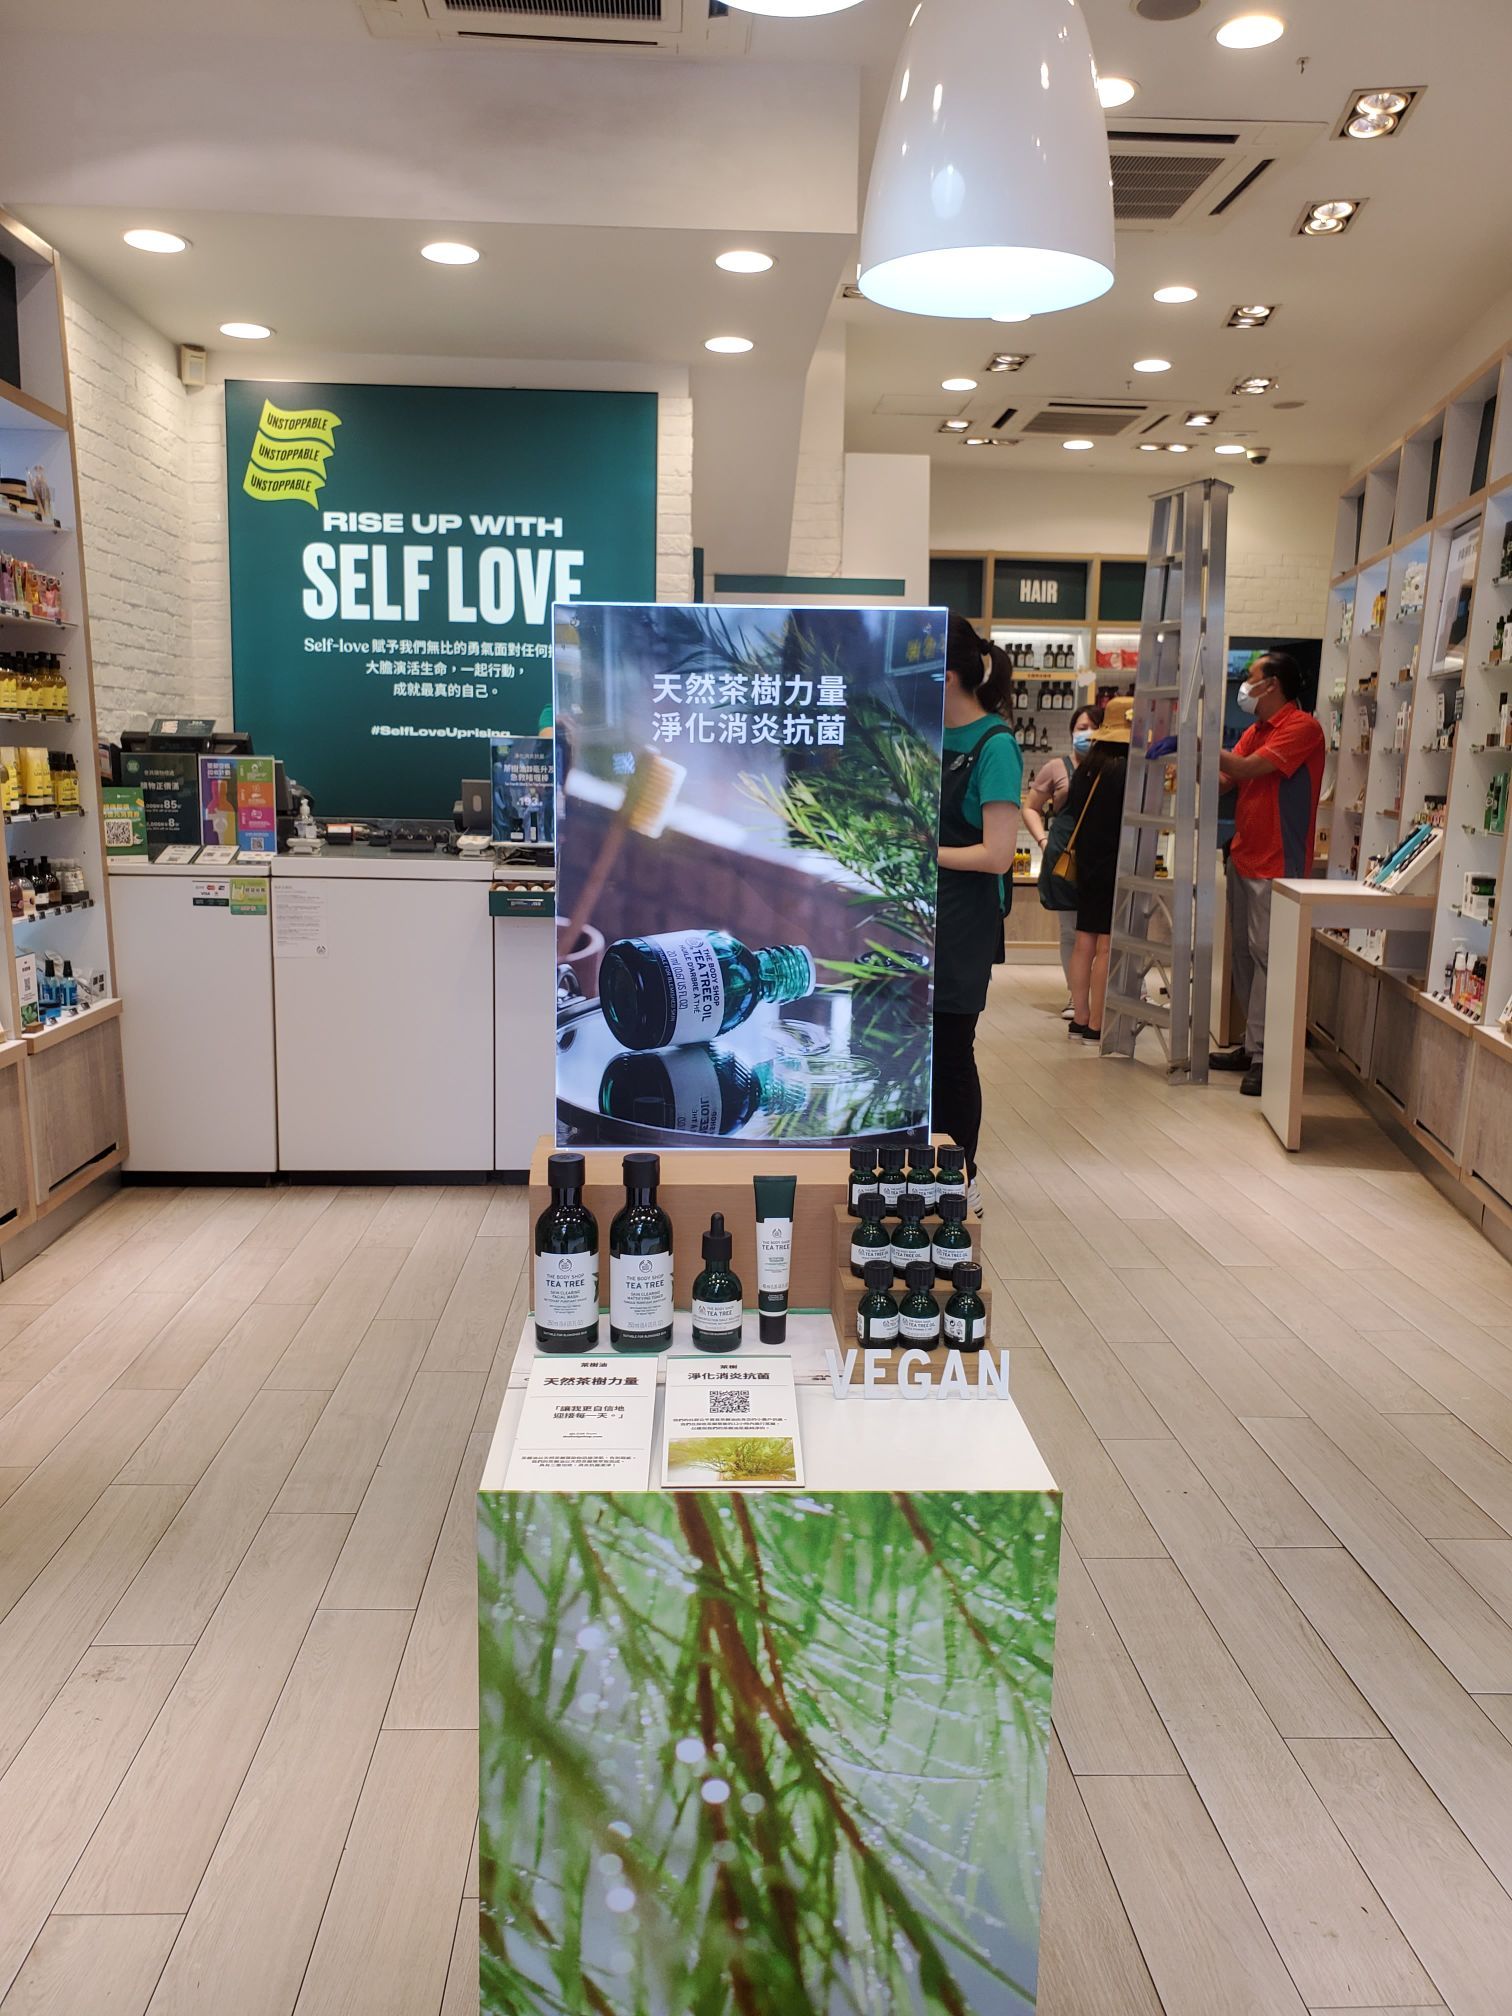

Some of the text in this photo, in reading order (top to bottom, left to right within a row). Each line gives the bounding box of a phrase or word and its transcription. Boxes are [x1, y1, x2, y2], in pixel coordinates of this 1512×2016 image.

[267, 412, 328, 431] UNSTOPPABLE
[258, 443, 320, 462] UNSTOPPABLE
[250, 474, 312, 492] UNSTOPPABLE
[323, 511, 564, 538] RISE UP WITH
[302, 542, 584, 625] SELF LOVE
[1020, 579, 1058, 604] HAIR
[304, 637, 370, 653] Self-love
[393, 682, 498, 698] 成就最真的自己。
[652, 673, 848, 708] 天然茶樹力量
[651, 711, 846, 746] 淨化消炎抗菌
[703, 949, 712, 962] THE
[708, 963, 718, 983] BODY
[693, 950, 712, 1022] TEA TREE OIL
[545, 1279, 585, 1288] TEA TREE
[625, 1280, 665, 1290] TEA TREE
[543, 1376, 640, 1386] 天然茶樹力量
[687, 1372, 771, 1380] 淨化消炎抗菌
[824, 1348, 1010, 1400] VEGAN
